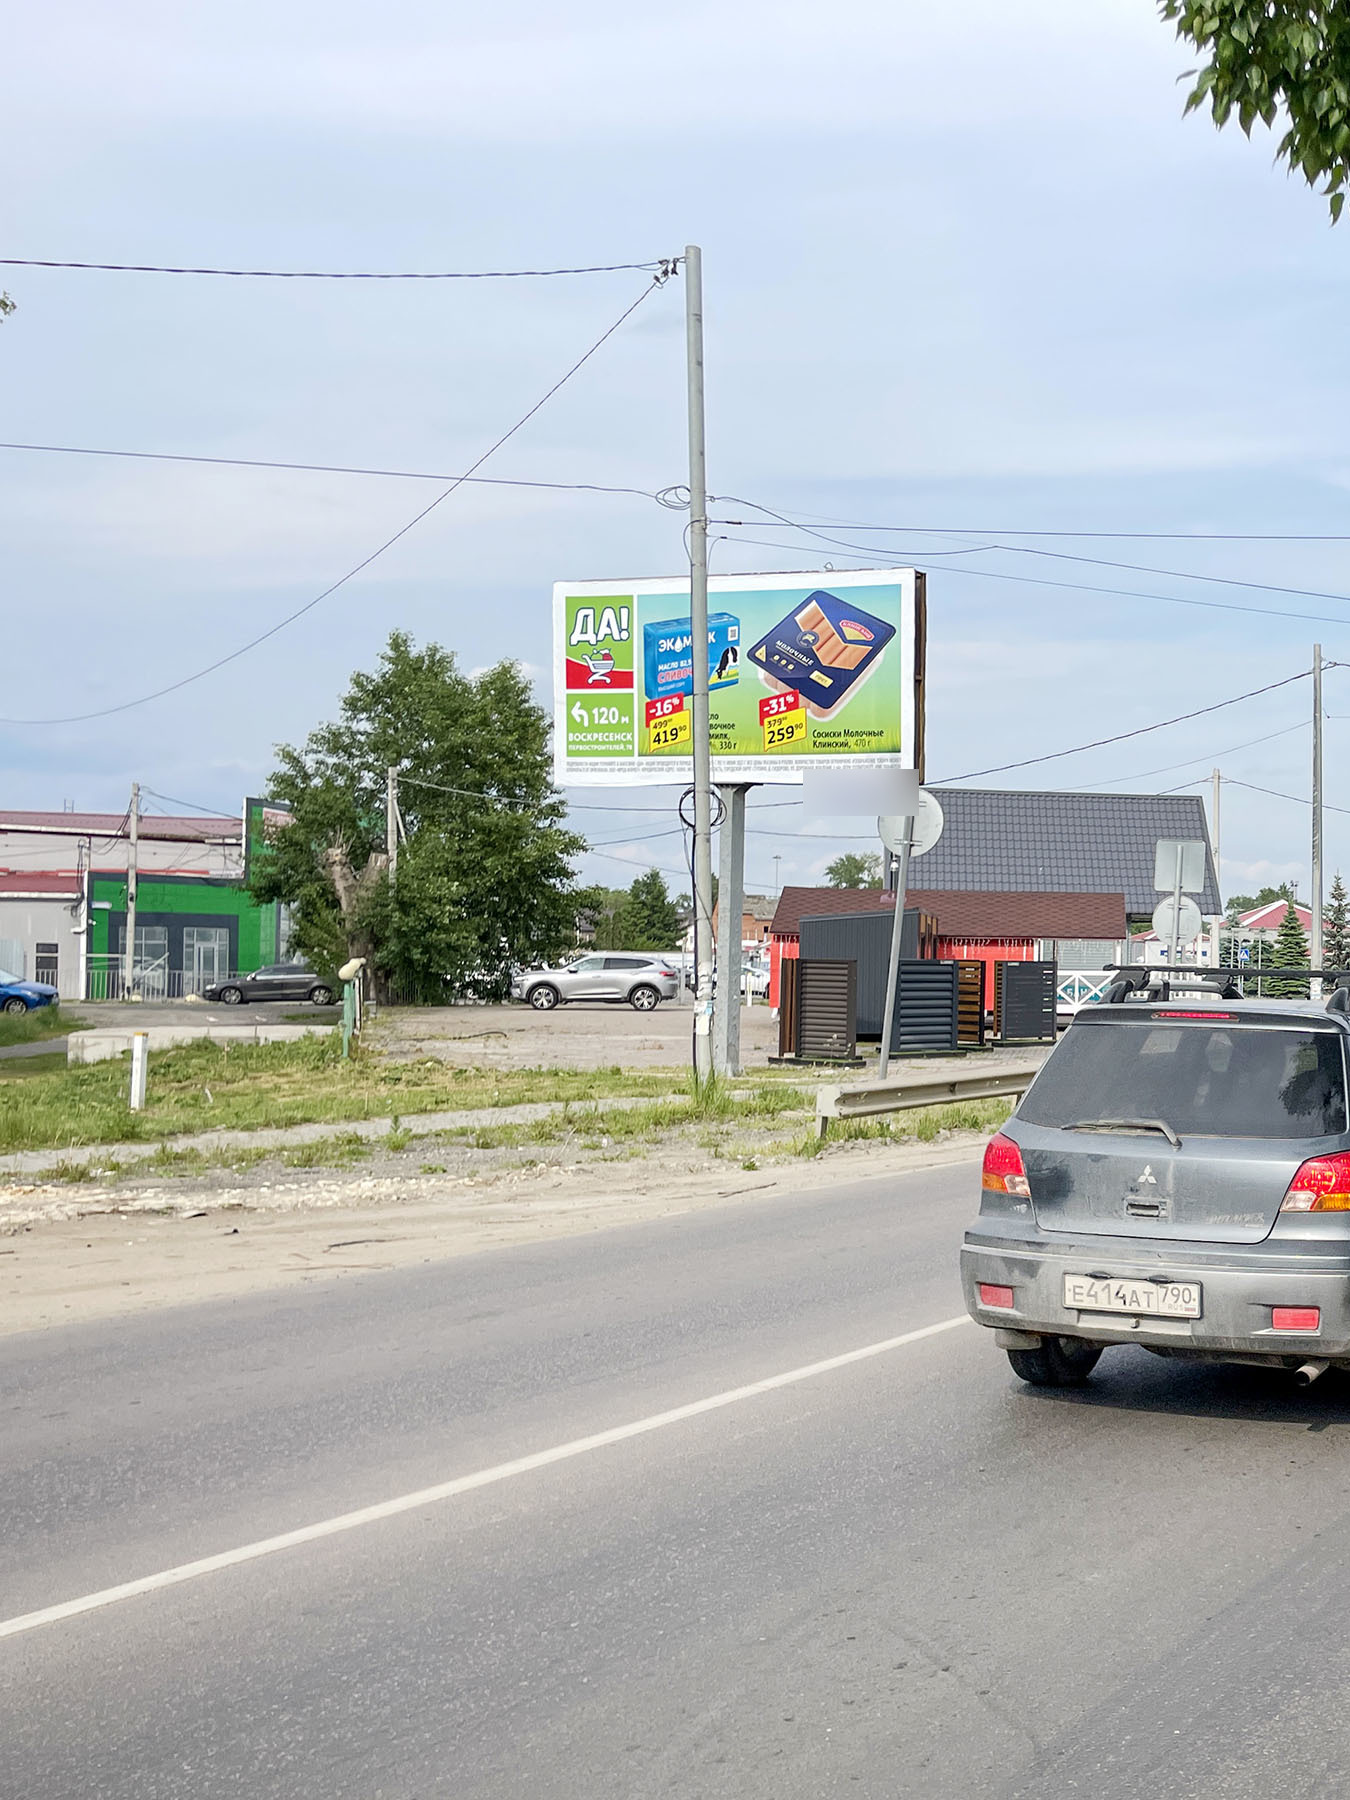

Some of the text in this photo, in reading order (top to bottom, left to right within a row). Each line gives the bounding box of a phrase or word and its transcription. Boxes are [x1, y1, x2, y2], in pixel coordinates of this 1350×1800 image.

[569, 606, 631, 647] ДА!
[775, 639, 815, 667] МОЛОЧНЫЕ
[649, 697, 680, 717] -16%
[763, 694, 795, 715] -31%
[592, 707, 619, 724] 120
[568, 732, 633, 742] ВОСКРЕСЕНСК
[812, 728, 885, 739] Сосиски Молочные
[720, 741, 732, 750] 330
[812, 740, 851, 749] Клинский,
[1072, 1281, 1193, 1309] Е414АТ 790
